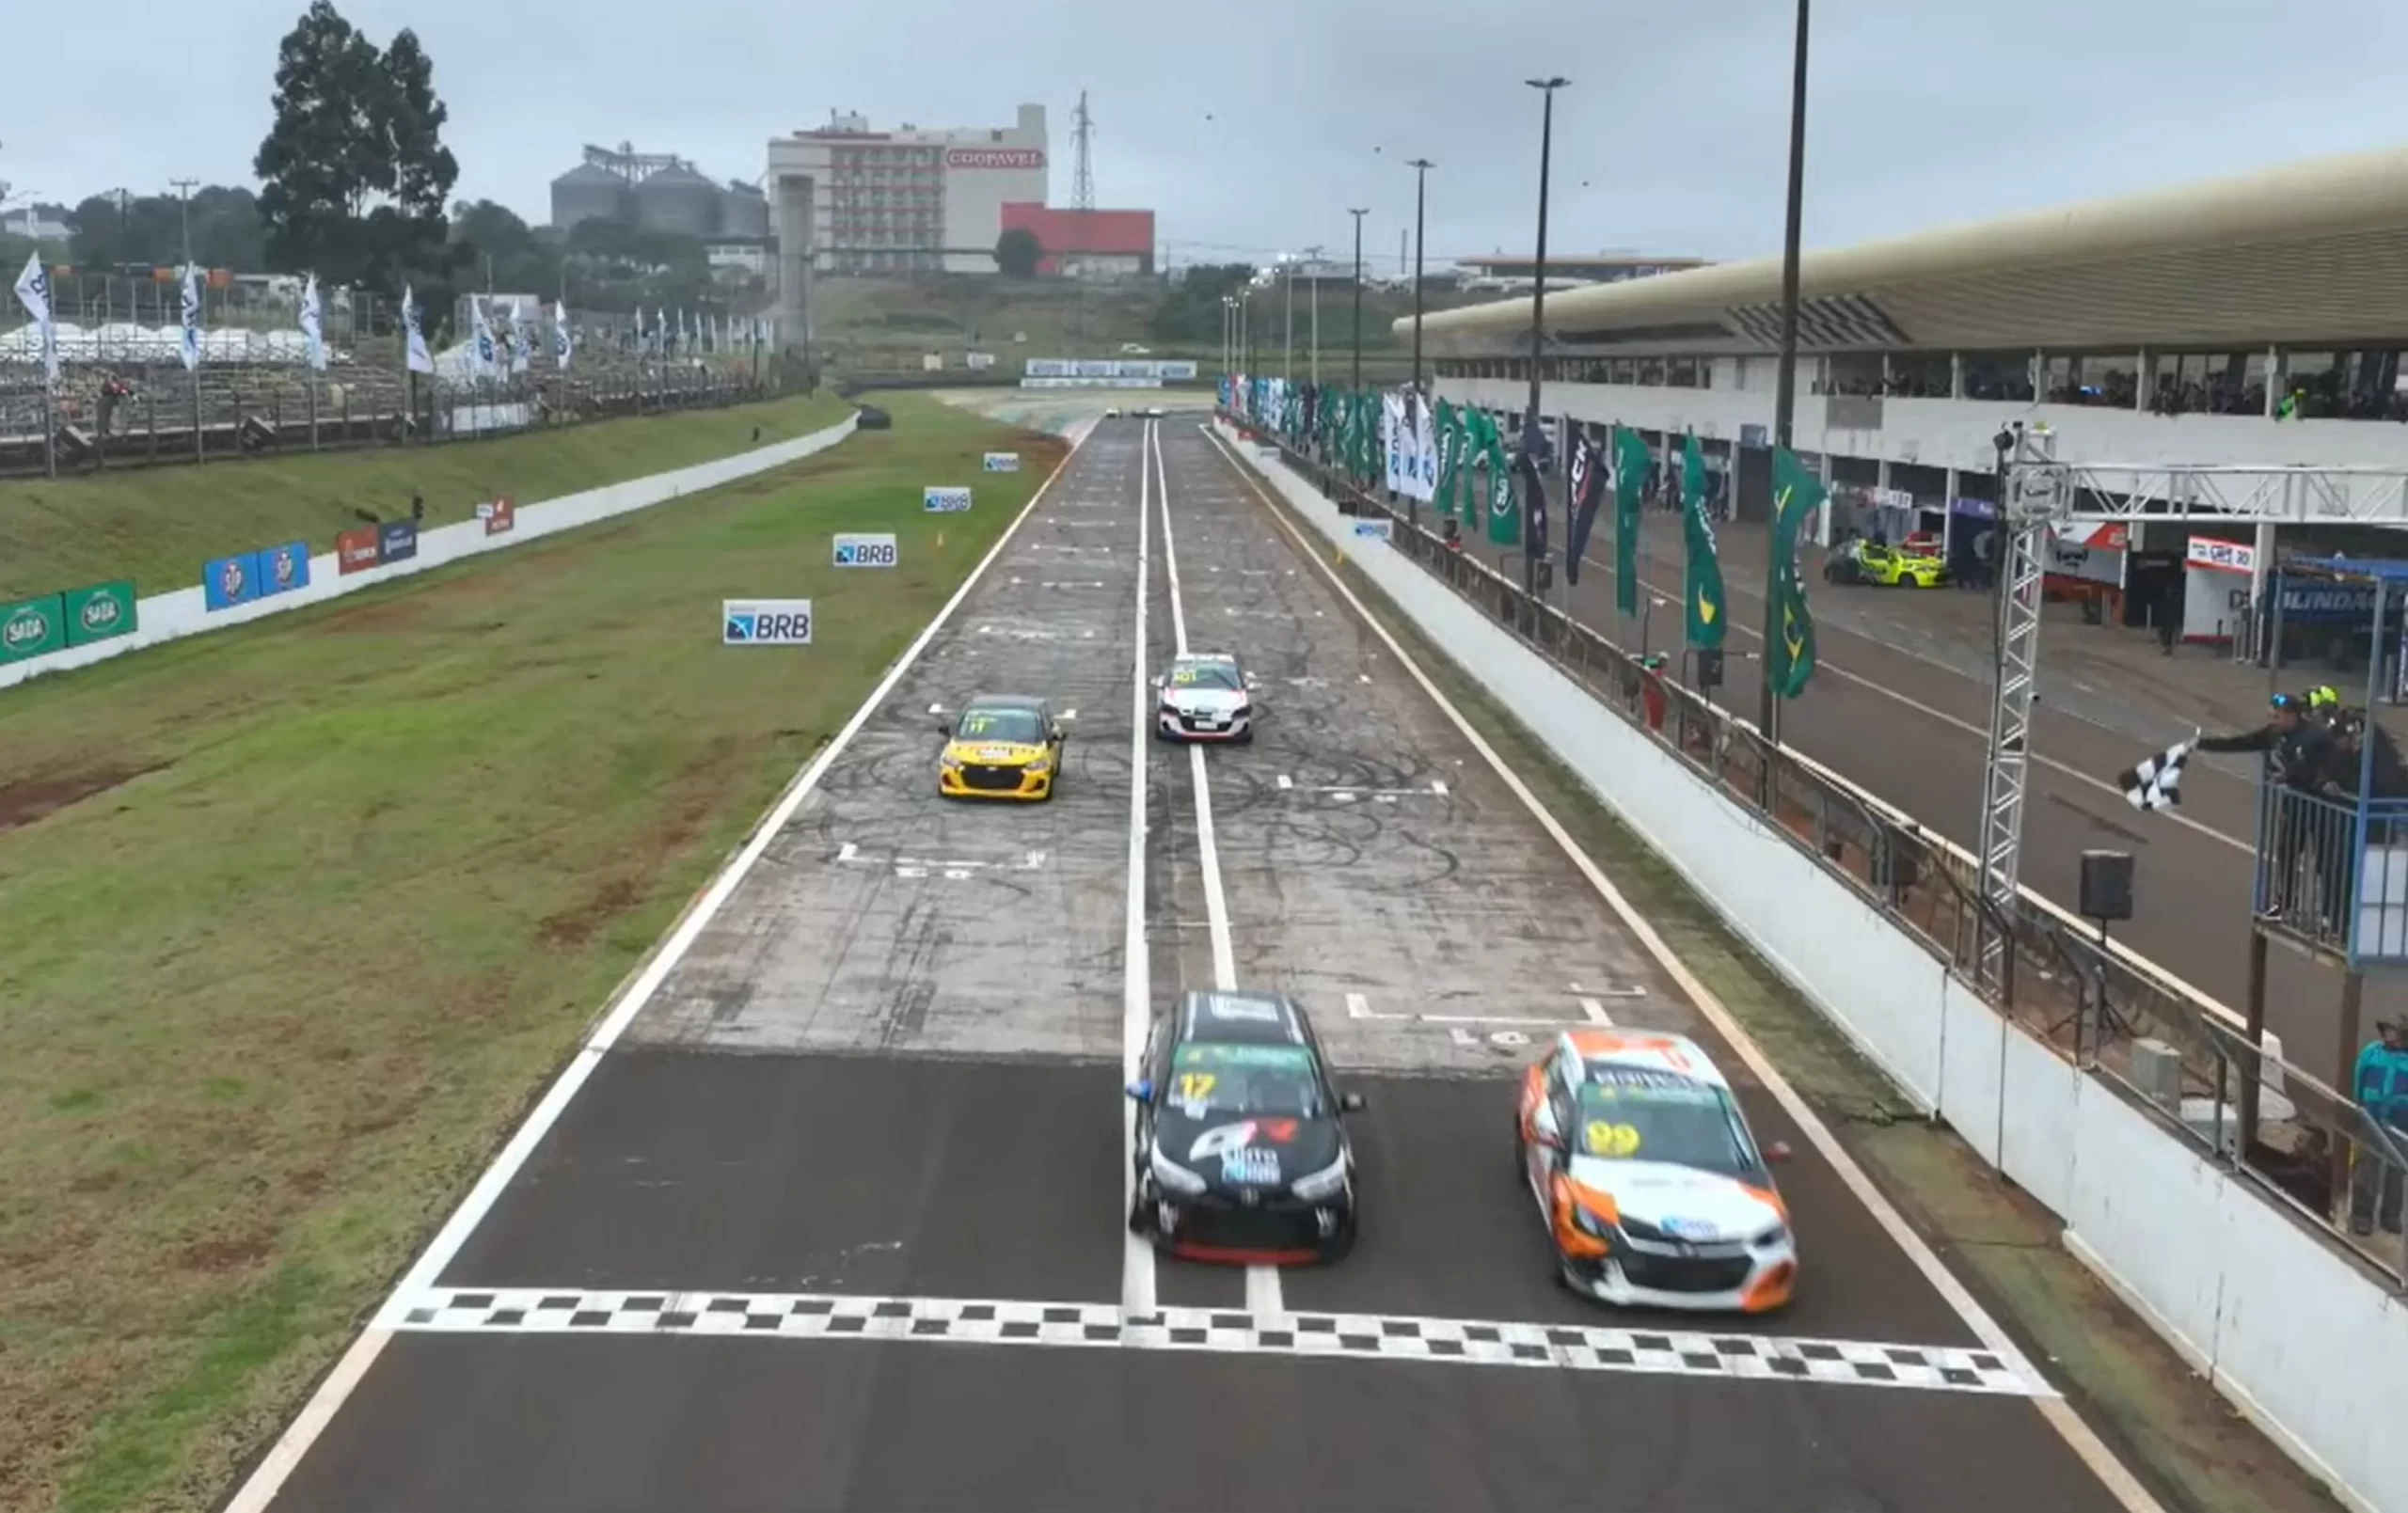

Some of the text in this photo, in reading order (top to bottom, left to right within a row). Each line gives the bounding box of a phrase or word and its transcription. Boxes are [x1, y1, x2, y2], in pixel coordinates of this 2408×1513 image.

[949, 152, 1041, 166] COOPAVEL
[856, 544, 895, 563] BRB
[86, 601, 117, 624] SADA
[8, 618, 44, 642] SADA
[755, 614, 810, 640] BRB
[1180, 1073, 1216, 1100] 17
[1587, 1122, 1640, 1158] 99
